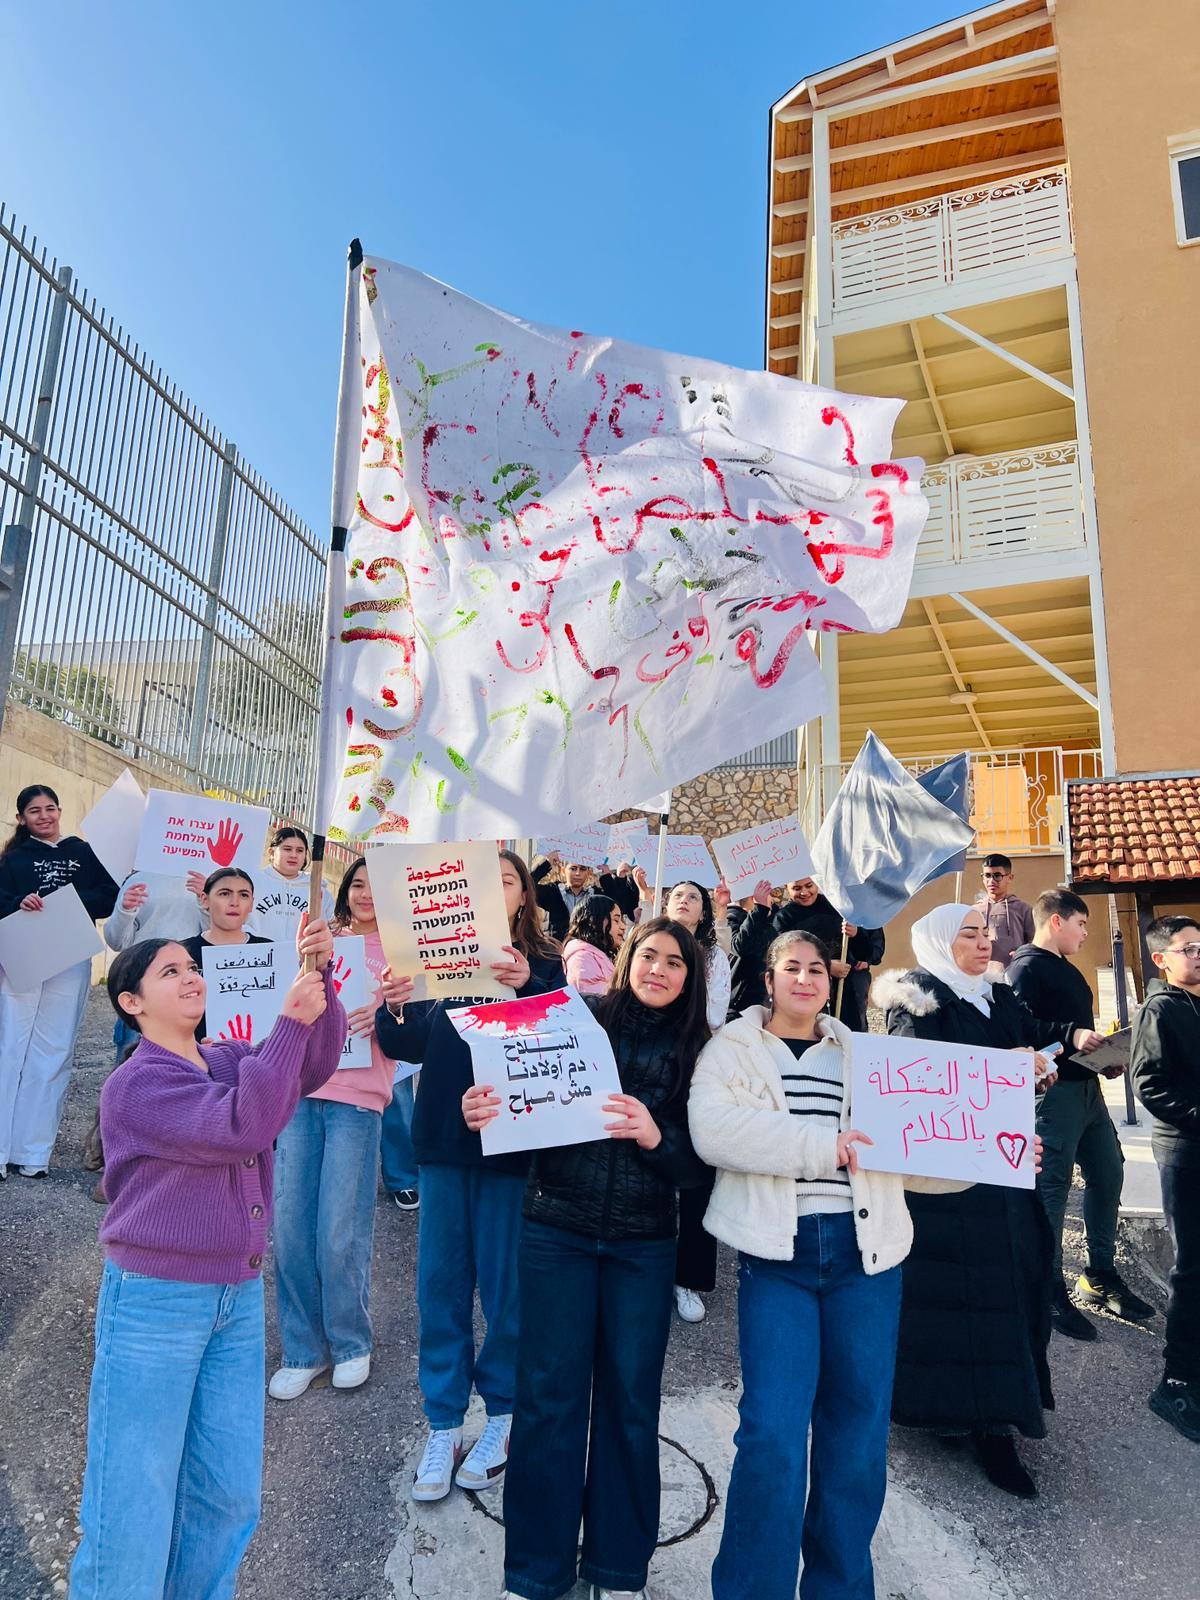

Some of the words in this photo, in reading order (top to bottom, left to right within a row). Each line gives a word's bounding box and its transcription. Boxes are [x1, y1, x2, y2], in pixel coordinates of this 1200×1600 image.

[167, 816, 184, 826] את
[189, 819, 214, 830] עצרו
[165, 831, 205, 844] מלחמת
[162, 845, 205, 858] הפשיעה
[406, 859, 464, 882] الحكومة
[409, 878, 468, 898] הממשלה
[256, 893, 282, 915] NEW
[286, 893, 309, 912] YOR
[412, 894, 470, 915] والشرطة
[413, 911, 475, 930] והמשטרה
[418, 924, 476, 945] شركاء
[423, 957, 481, 971] بالجريمة
[436, 970, 473, 981] לפשע
[504, 1034, 579, 1062] السلاح
[506, 1053, 563, 1082] أولادنا
[568, 1059, 587, 1080] دم
[508, 1088, 556, 1114] مباح
[560, 1080, 592, 1106] مش
